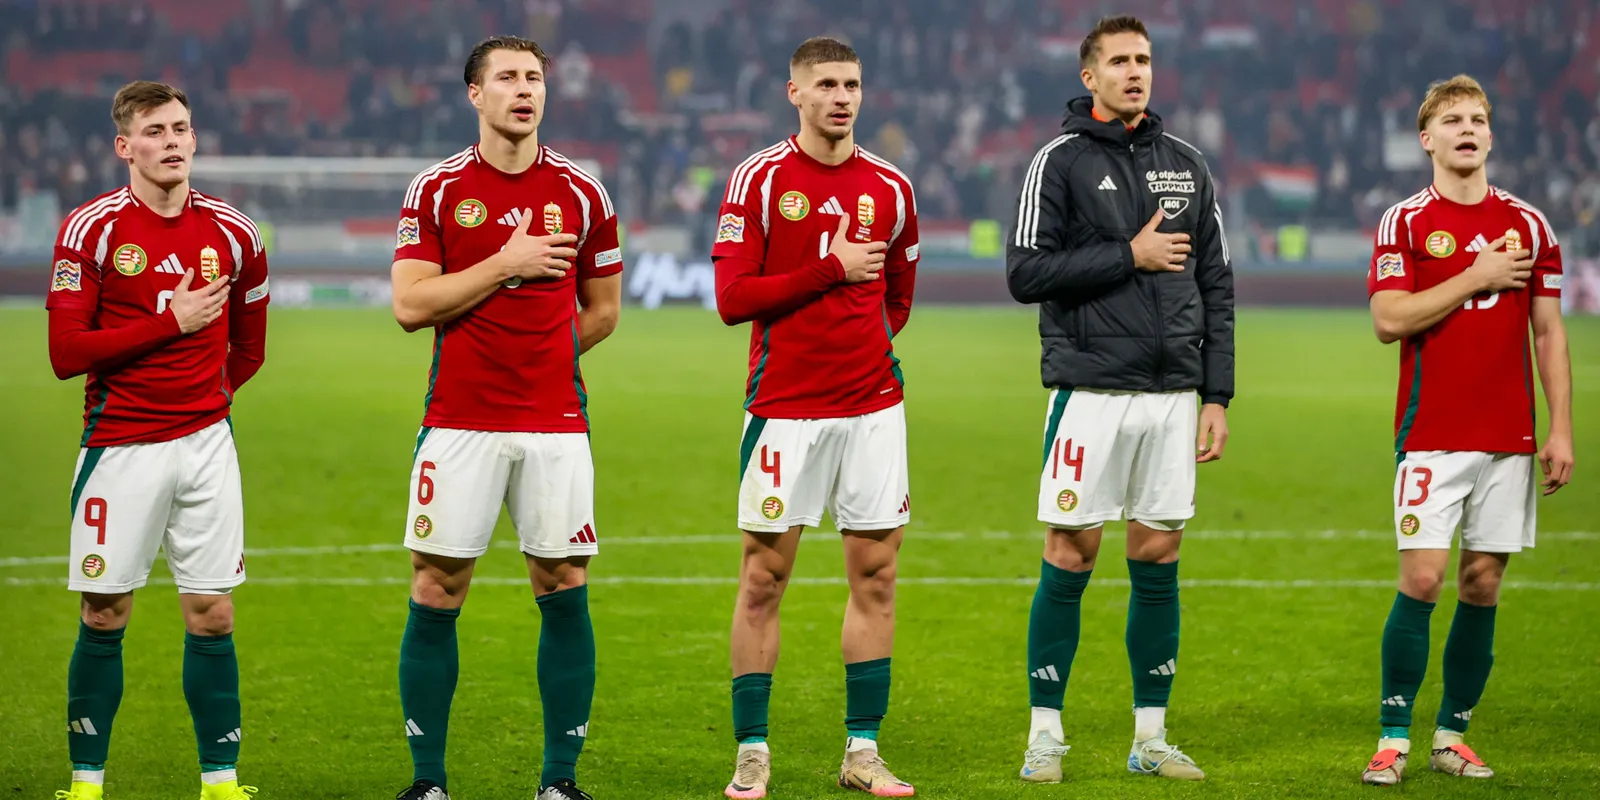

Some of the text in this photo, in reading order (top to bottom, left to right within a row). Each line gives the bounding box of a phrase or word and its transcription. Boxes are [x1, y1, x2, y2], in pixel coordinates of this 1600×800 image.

[761, 444, 780, 488] 4
[1052, 437, 1084, 481] 14
[418, 461, 436, 505] 6
[1398, 466, 1432, 507] 13
[84, 497, 107, 545] 9
